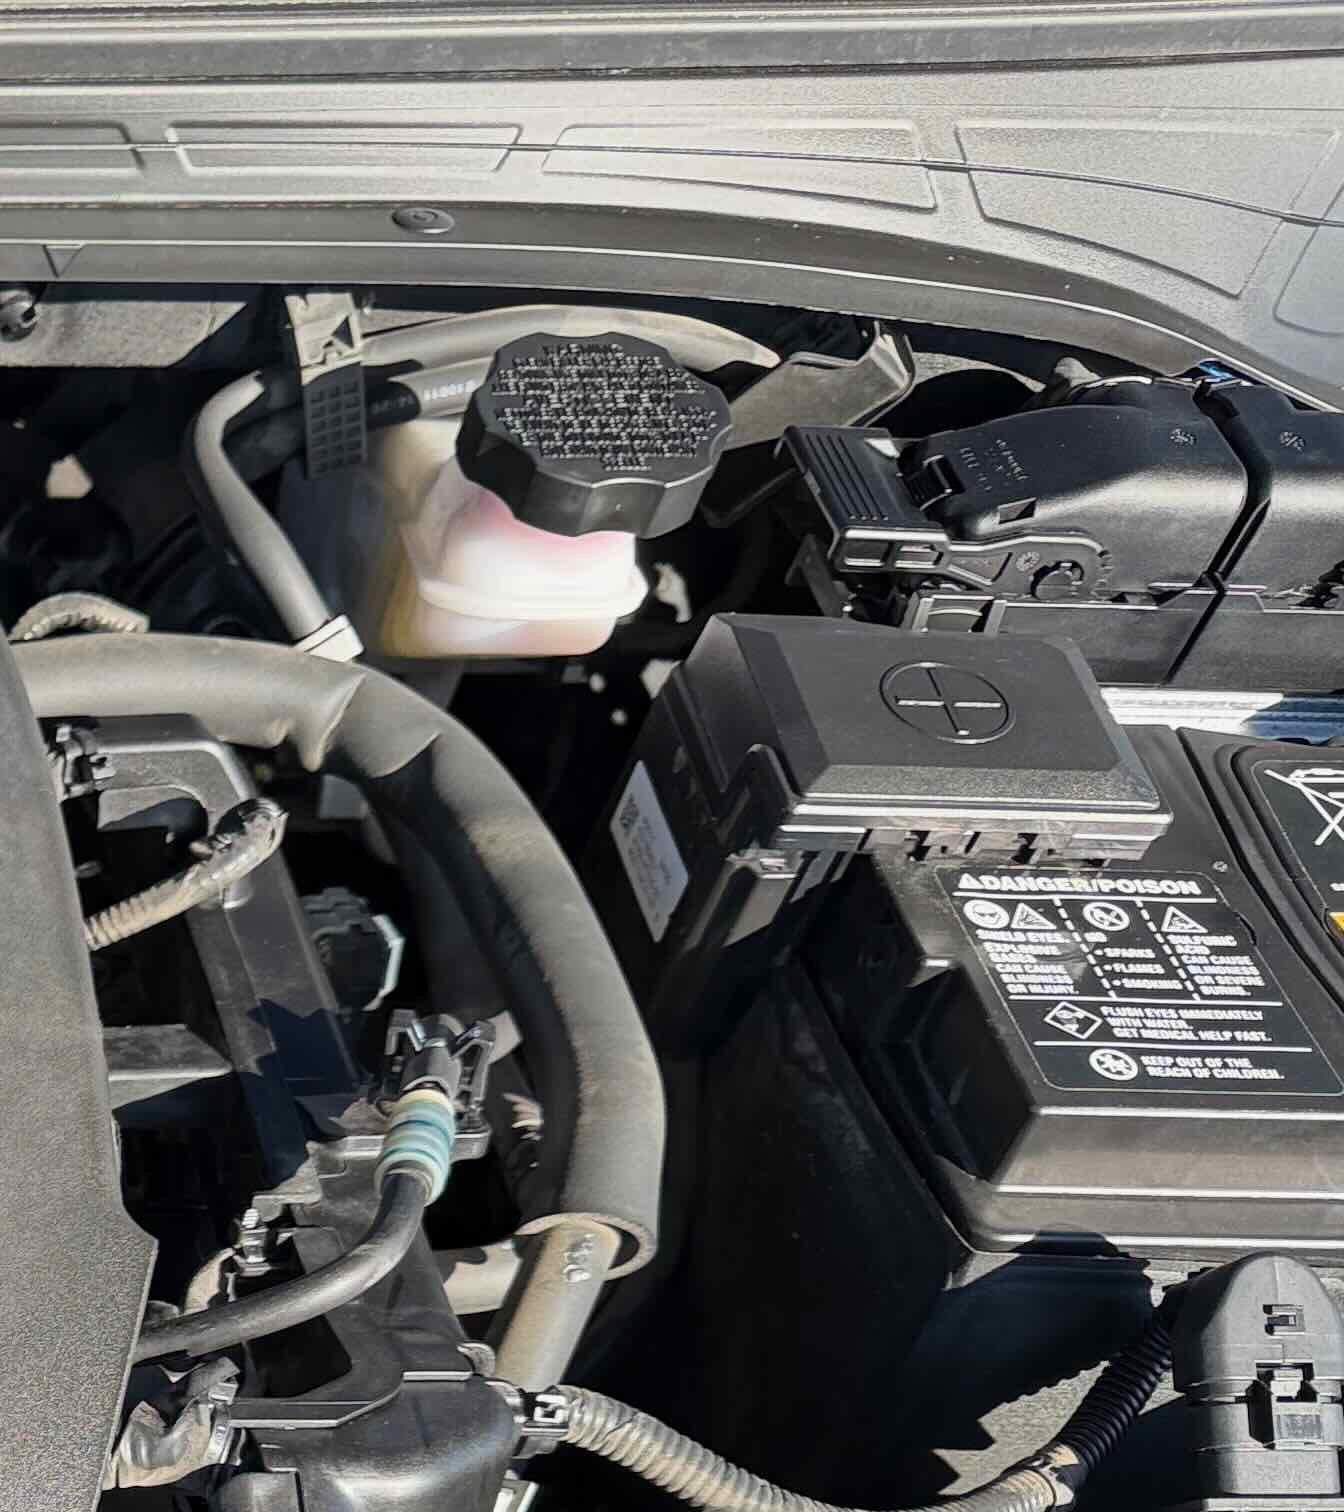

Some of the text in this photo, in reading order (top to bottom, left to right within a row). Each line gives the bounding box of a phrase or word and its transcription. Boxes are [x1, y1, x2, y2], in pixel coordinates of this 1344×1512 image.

[979, 875, 1201, 895] DANGER/POISON
[976, 929, 1025, 942] SHIELD
[983, 941, 1062, 955] EXPLOSIVE
[1104, 948, 1156, 958] SPARKS
[1175, 945, 1210, 955] ACID
[1181, 955, 1253, 965] CAN CAUSE
[995, 963, 1068, 974] CAN CAUSE
[1113, 963, 1165, 974] FLAMES
[1186, 965, 1260, 976] BLINDNESS
[1000, 974, 1074, 985] BLINDNESS
[1122, 978, 1183, 990] SMOKING
[1193, 975, 1265, 986] OR SEVERE
[1006, 984, 1027, 993] OR
[1100, 1006, 1263, 1021] FLUSH EYES IMMEDIATELY
[1106, 1017, 1193, 1030] WITH WATER.
[1113, 1027, 1272, 1042] GET MEDICAL HELP FAST.
[1140, 1055, 1253, 1069] KEEP OUT OF THE
[1147, 1066, 1285, 1079] REACH OF CHILDREN.
